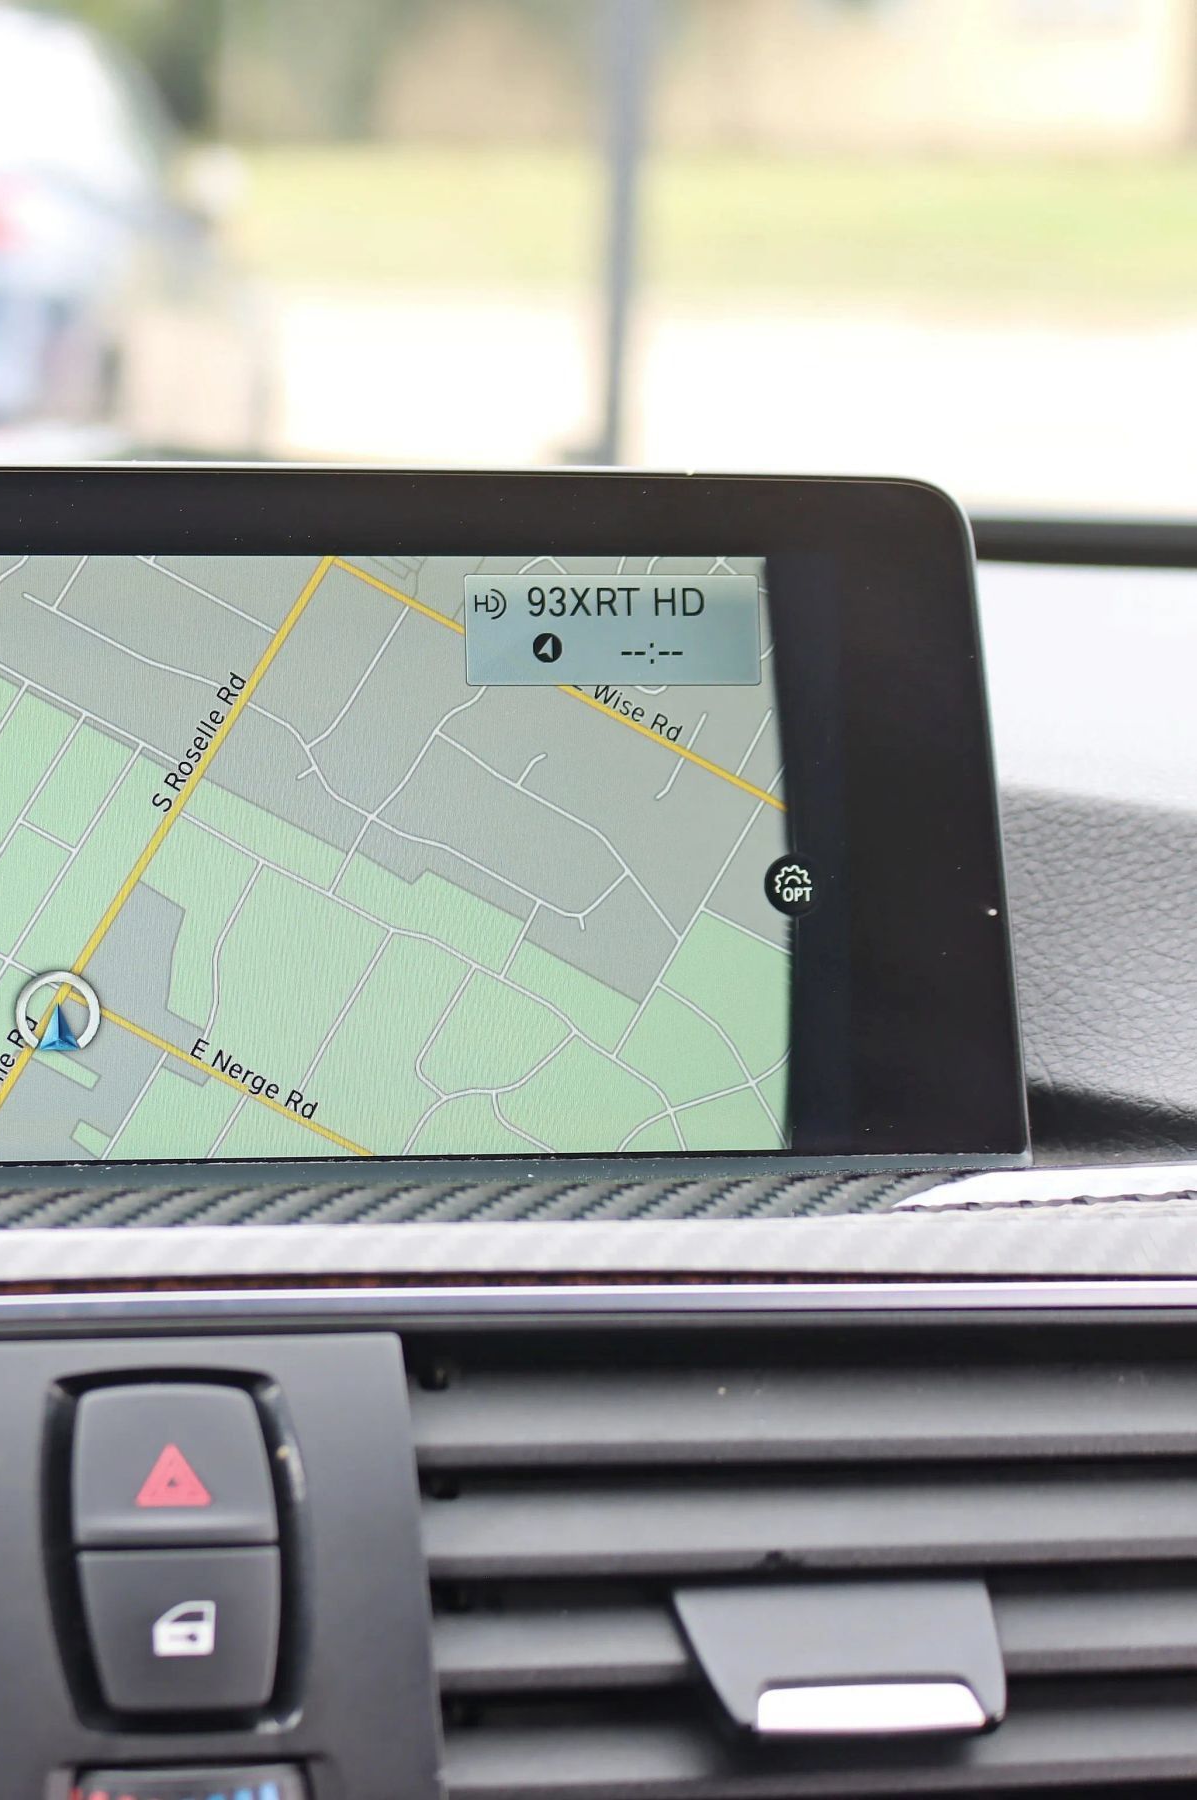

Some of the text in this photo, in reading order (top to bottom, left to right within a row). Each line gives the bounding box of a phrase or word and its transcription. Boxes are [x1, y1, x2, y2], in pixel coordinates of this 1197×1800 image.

[527, 586, 705, 617] 93XRT HD
[152, 672, 246, 812] S Roselle Rd
[594, 685, 683, 742] Wise Rd
[783, 887, 813, 902] OPT
[190, 1038, 318, 1120] E Nerge Rd
